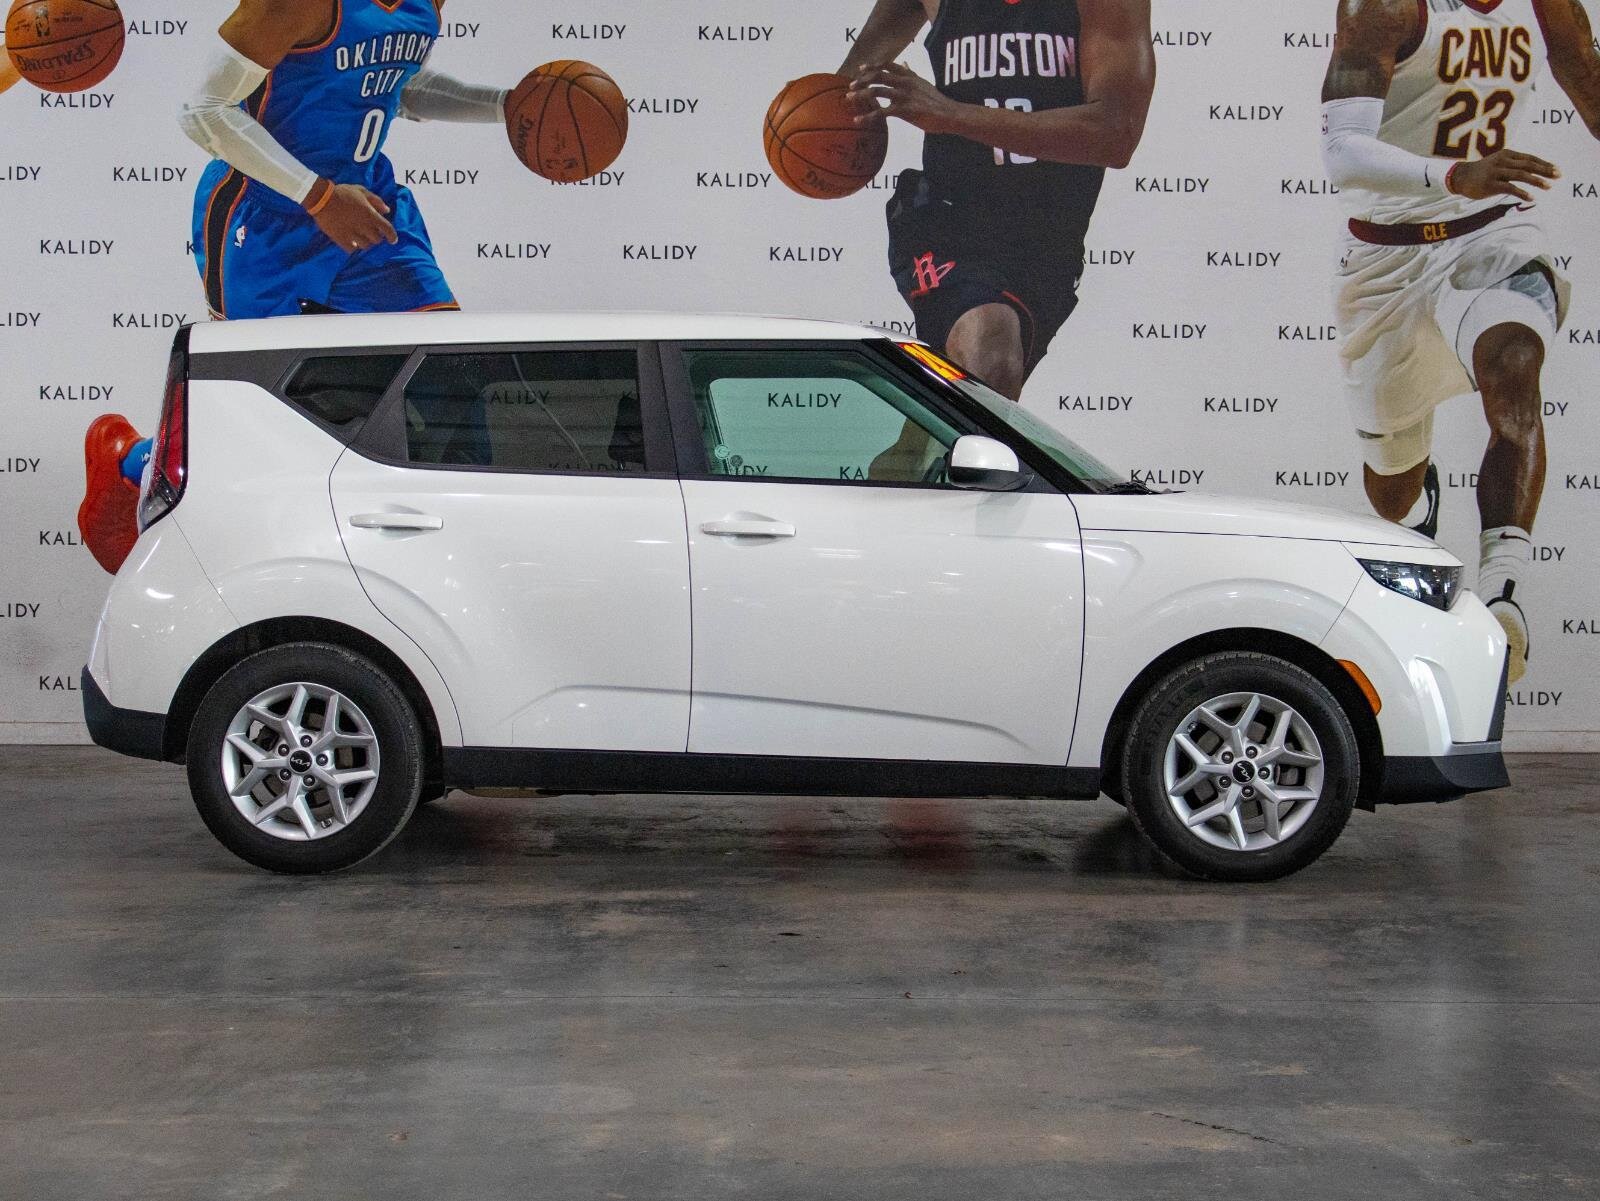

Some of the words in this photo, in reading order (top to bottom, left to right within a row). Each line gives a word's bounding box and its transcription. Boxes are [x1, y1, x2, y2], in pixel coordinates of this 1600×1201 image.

[128, 20, 188, 35] ALIDY
[438, 23, 480, 38] IDY
[552, 24, 626, 39] KALIDY
[699, 26, 774, 41] KALIDY
[1152, 31, 1212, 46] ALIDY
[1284, 32, 1337, 47] KALI
[336, 33, 431, 71] OKLAHOM
[944, 32, 1076, 86] HOUSTON
[1438, 25, 1531, 84] CAVS
[360, 68, 404, 97] CITY
[40, 93, 114, 108] KALIDY
[625, 98, 699, 114] KALIDY
[1210, 105, 1284, 120] KALIDY
[1532, 109, 1575, 124] IDY
[1433, 90, 1515, 158] 23
[353, 108, 386, 163] 0
[0, 166, 41, 181] IDY
[113, 167, 187, 182] KALIDY
[405, 170, 479, 185] KALIDY
[697, 173, 771, 188] KALIDY
[1135, 178, 1210, 193] KALIDY
[1423, 223, 1448, 241] CLE
[40, 240, 114, 255] KALIDY
[477, 243, 551, 259] KALIDY
[623, 245, 697, 260] KALIDY
[770, 247, 844, 262] KALIDY
[1082, 250, 1135, 265] LIDY
[1207, 252, 1281, 267] KALIDY
[0, 312, 41, 327] IDY
[113, 313, 187, 328] KALIDY
[1133, 324, 1207, 340] KALIDY
[1278, 326, 1337, 341] KALID
[40, 386, 114, 401] KALIDY
[490, 390, 550, 405] ALIDY
[768, 393, 842, 408] KALIDY
[1059, 396, 1133, 411] KALIDY
[1204, 398, 1278, 413] KALIDY
[0, 458, 40, 473] IDY
[1130, 469, 1204, 485] KALIDY
[1276, 471, 1350, 486] KALIDY
[1566, 474, 1600, 489] KAL
[1532, 546, 1566, 561] IDY
[0, 603, 40, 618] IDY
[1563, 619, 1600, 634] KAL
[1506, 691, 1563, 706] ALIDY
